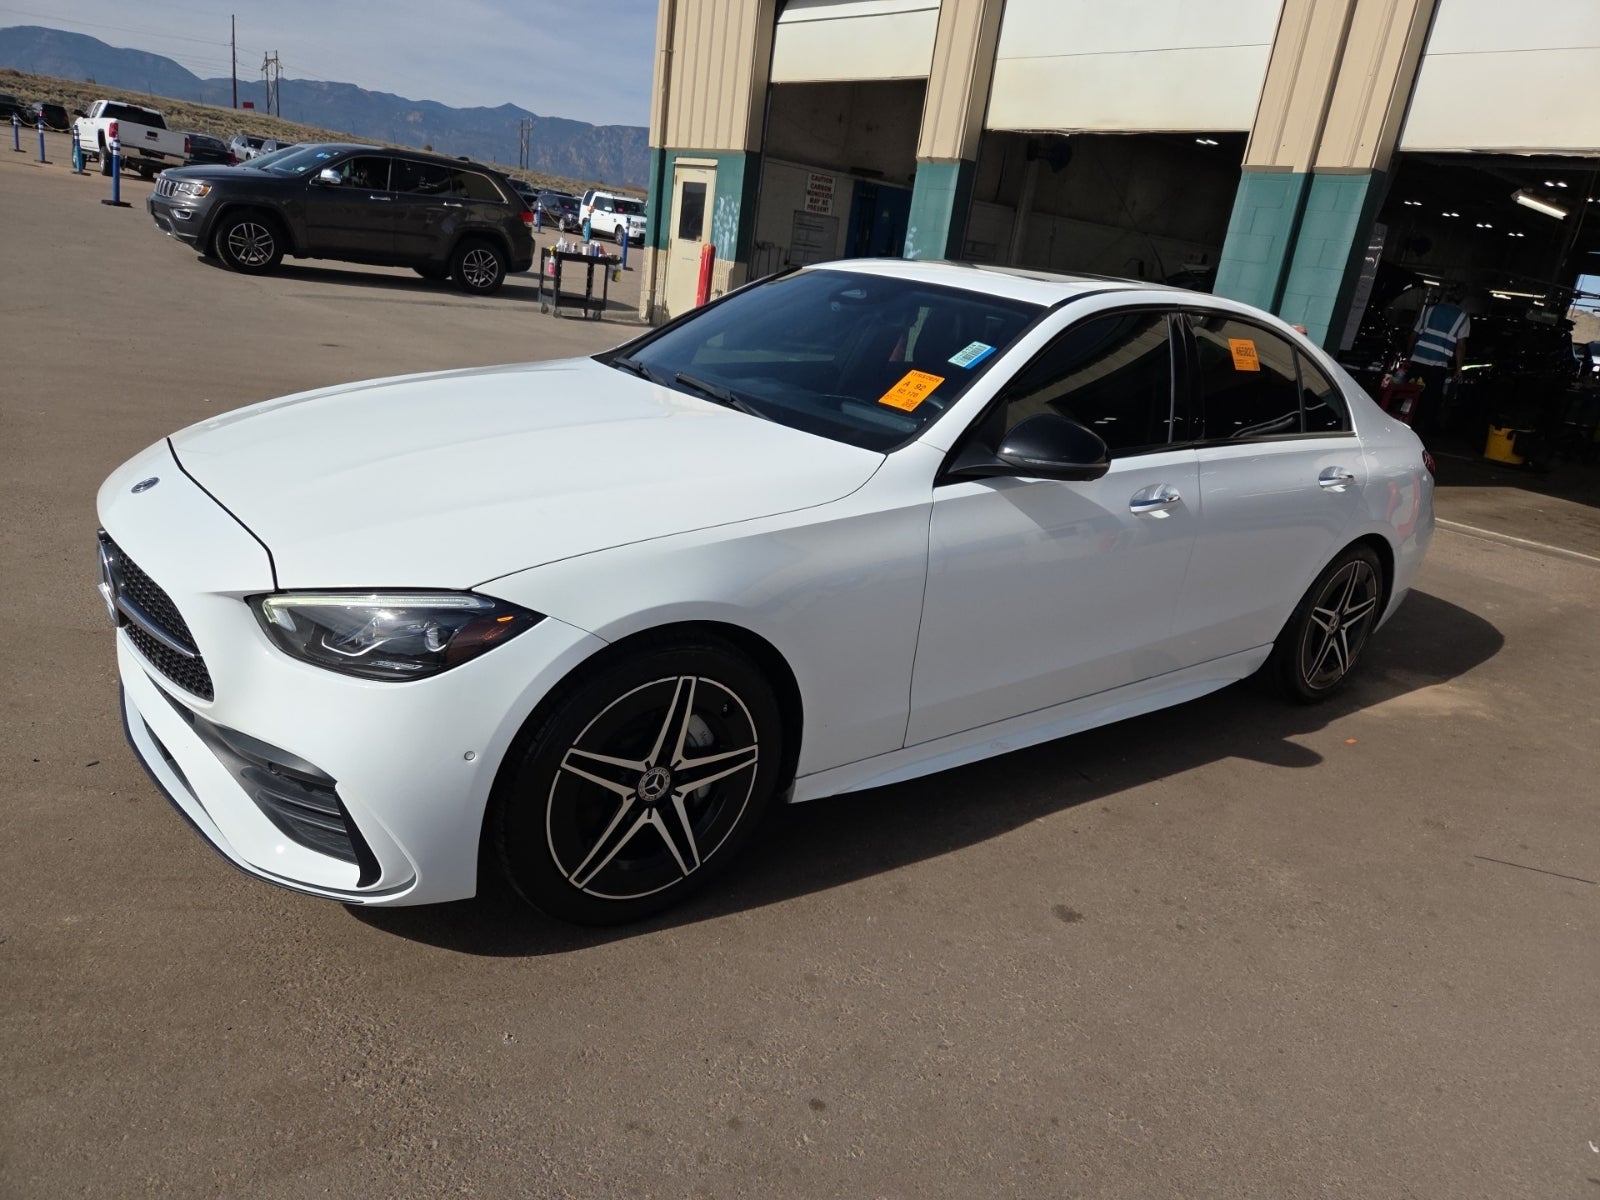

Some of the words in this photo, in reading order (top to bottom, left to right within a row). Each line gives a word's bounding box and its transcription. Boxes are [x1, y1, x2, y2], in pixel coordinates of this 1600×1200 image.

[811, 175, 833, 184] CAUTION
[811, 183, 832, 192] CARBON
[807, 190, 833, 200] MONOXIDE
[806, 204, 829, 213] PRESENT
